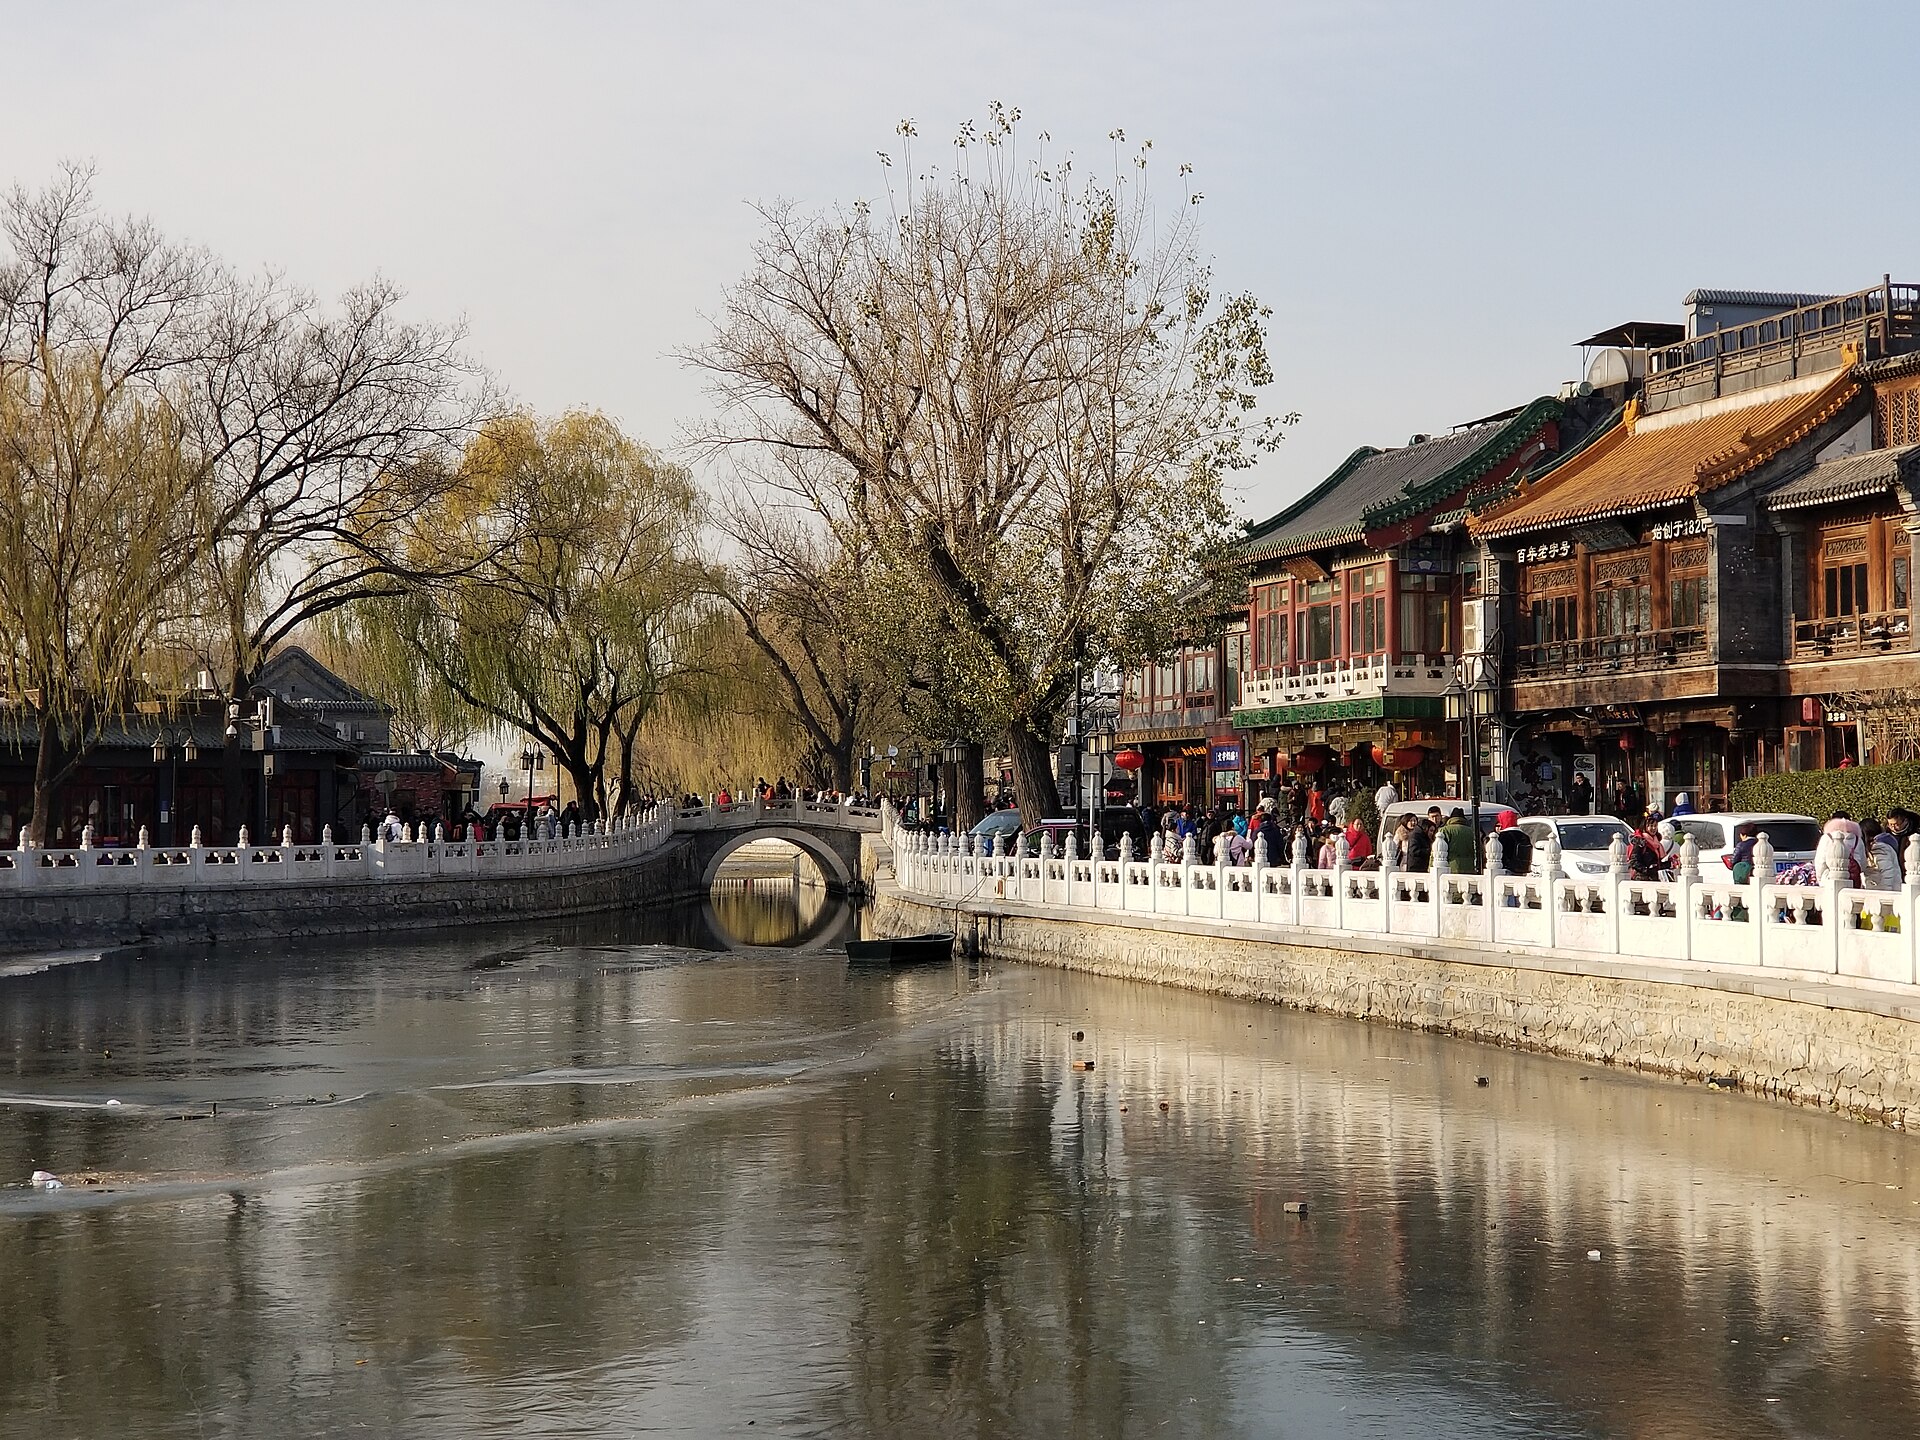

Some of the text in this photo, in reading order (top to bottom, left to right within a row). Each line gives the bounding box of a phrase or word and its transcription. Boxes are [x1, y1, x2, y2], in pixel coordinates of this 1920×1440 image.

[1651, 519, 1707, 540] 始创于1820
[1517, 541, 1570, 563] 百年老字号
